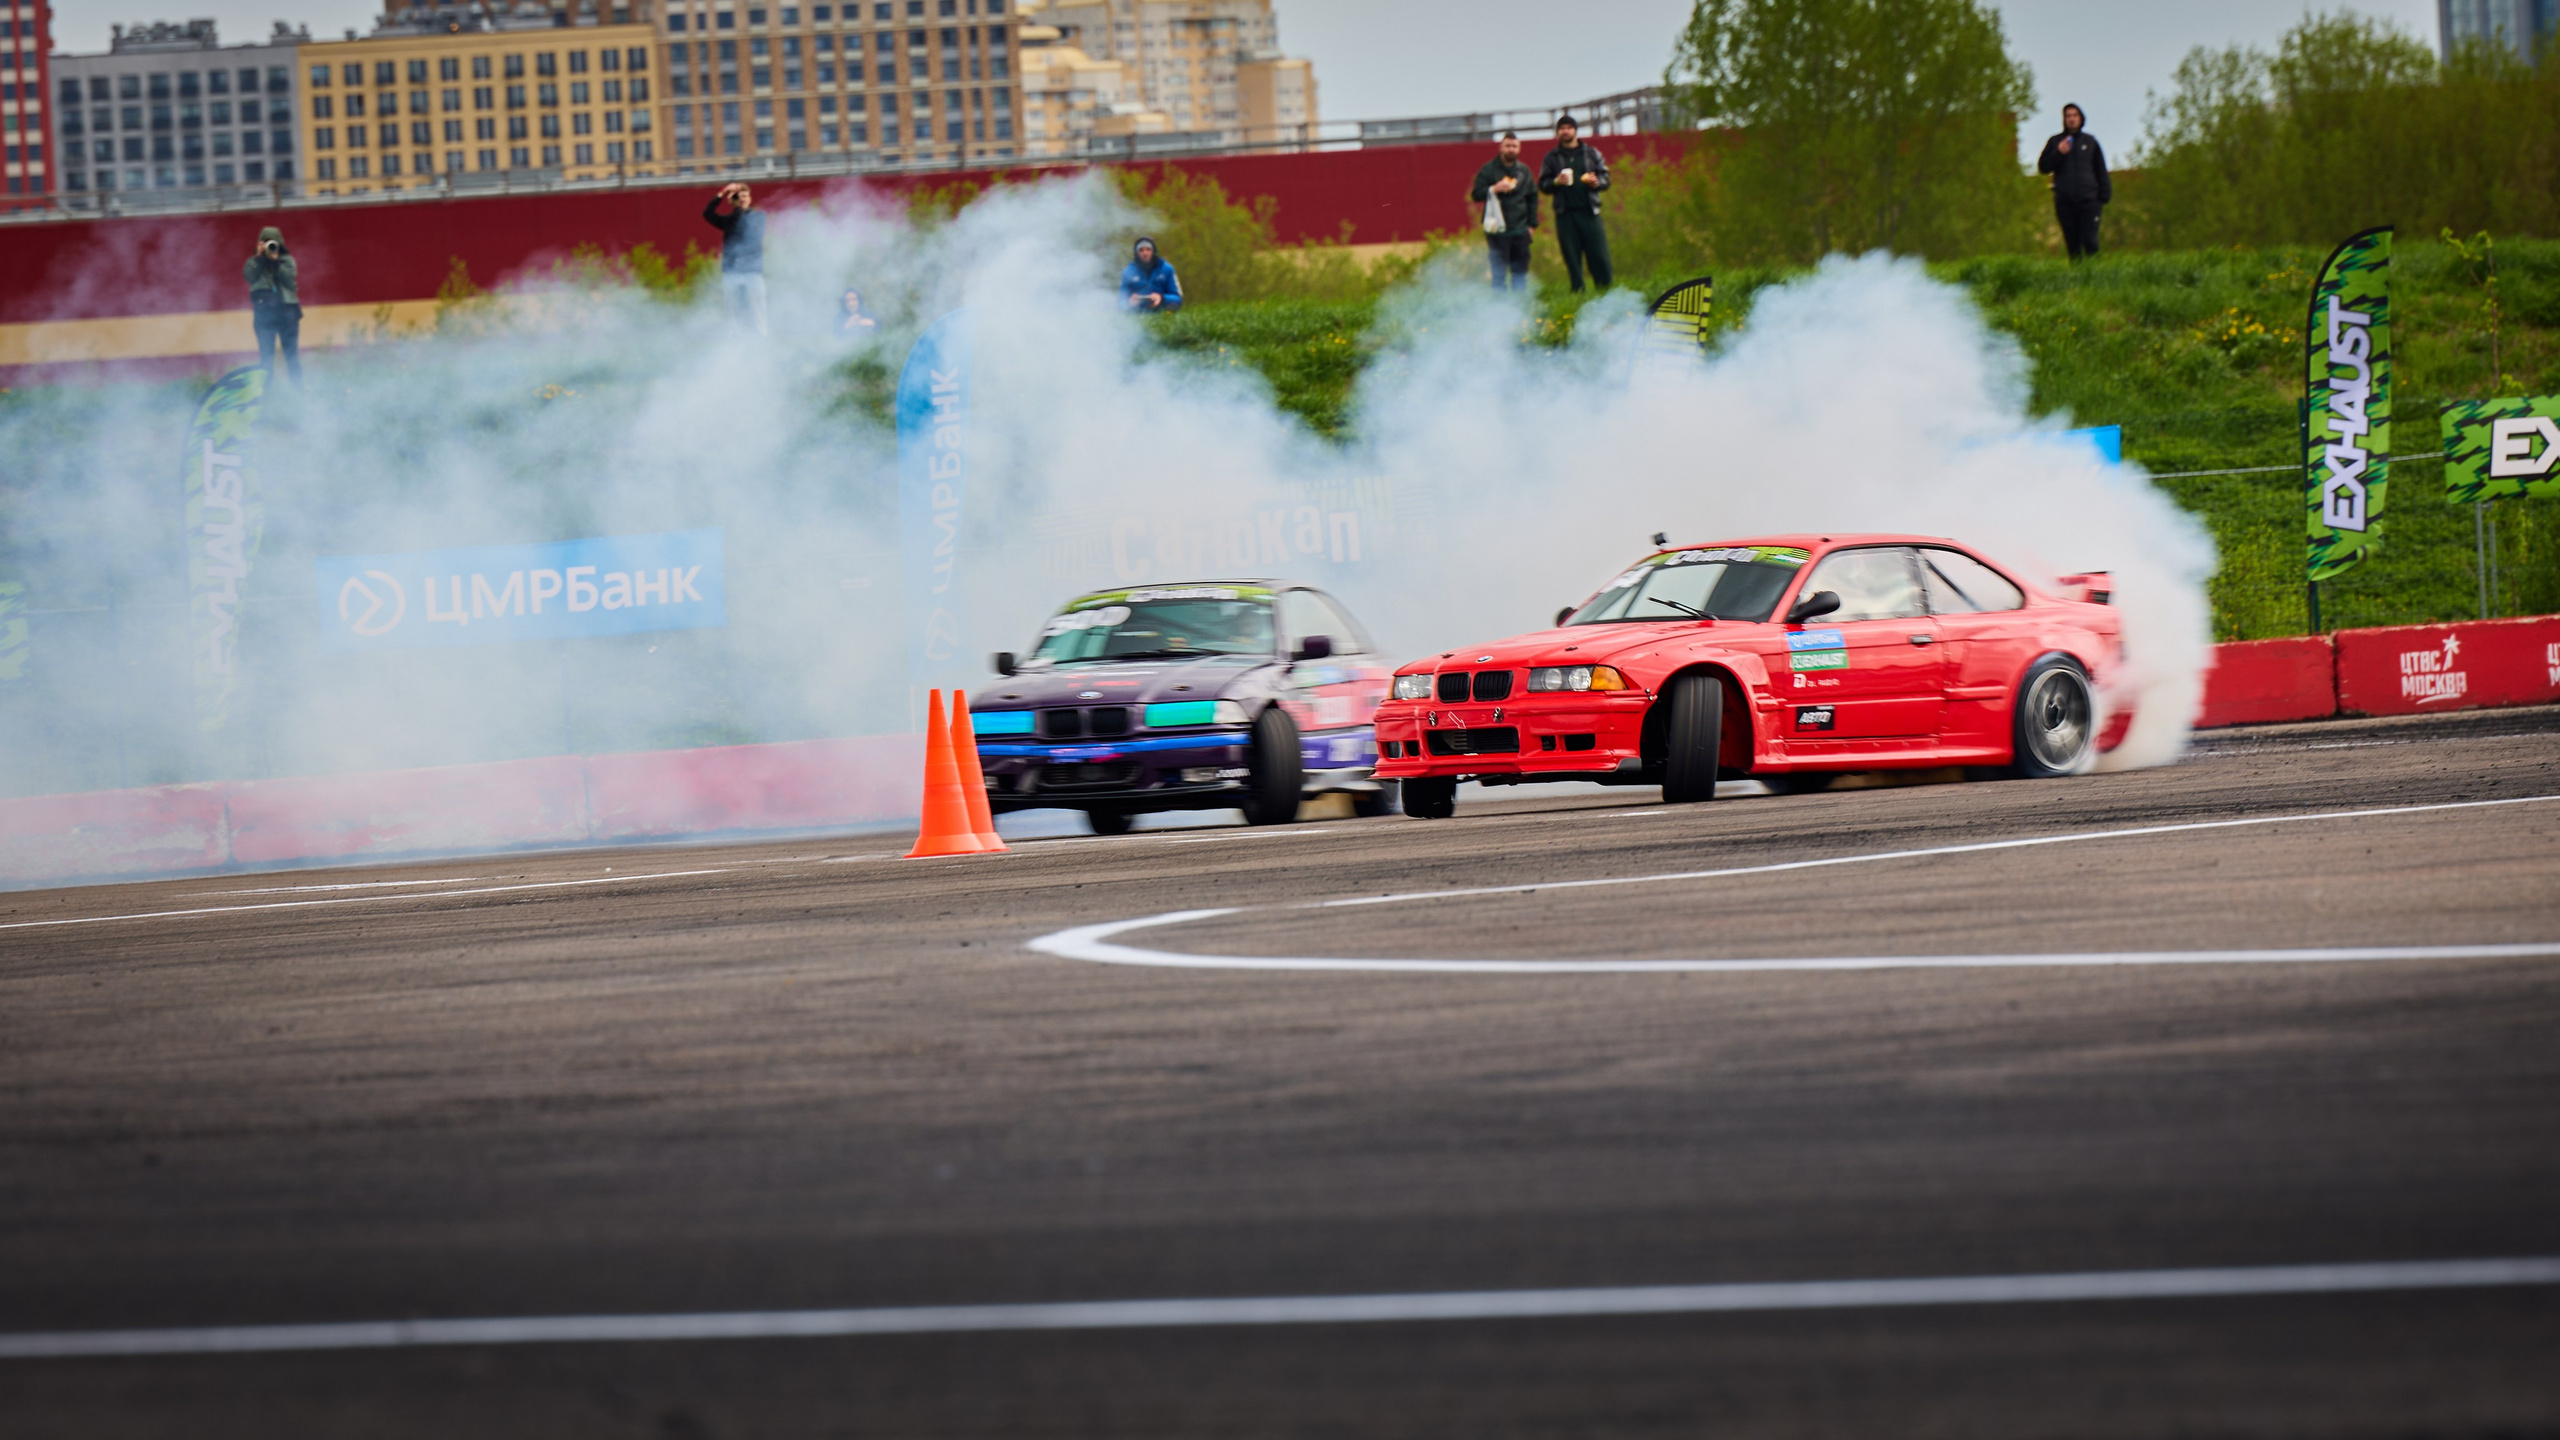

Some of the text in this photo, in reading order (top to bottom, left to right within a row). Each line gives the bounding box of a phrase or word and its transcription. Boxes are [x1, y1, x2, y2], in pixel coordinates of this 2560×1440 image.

[2322, 293, 2372, 533] EXHAUST
[424, 564, 704, 627] ЦМРБанк
[2400, 650, 2441, 676] ЦТВС
[2401, 671, 2468, 698] МОСКВА
